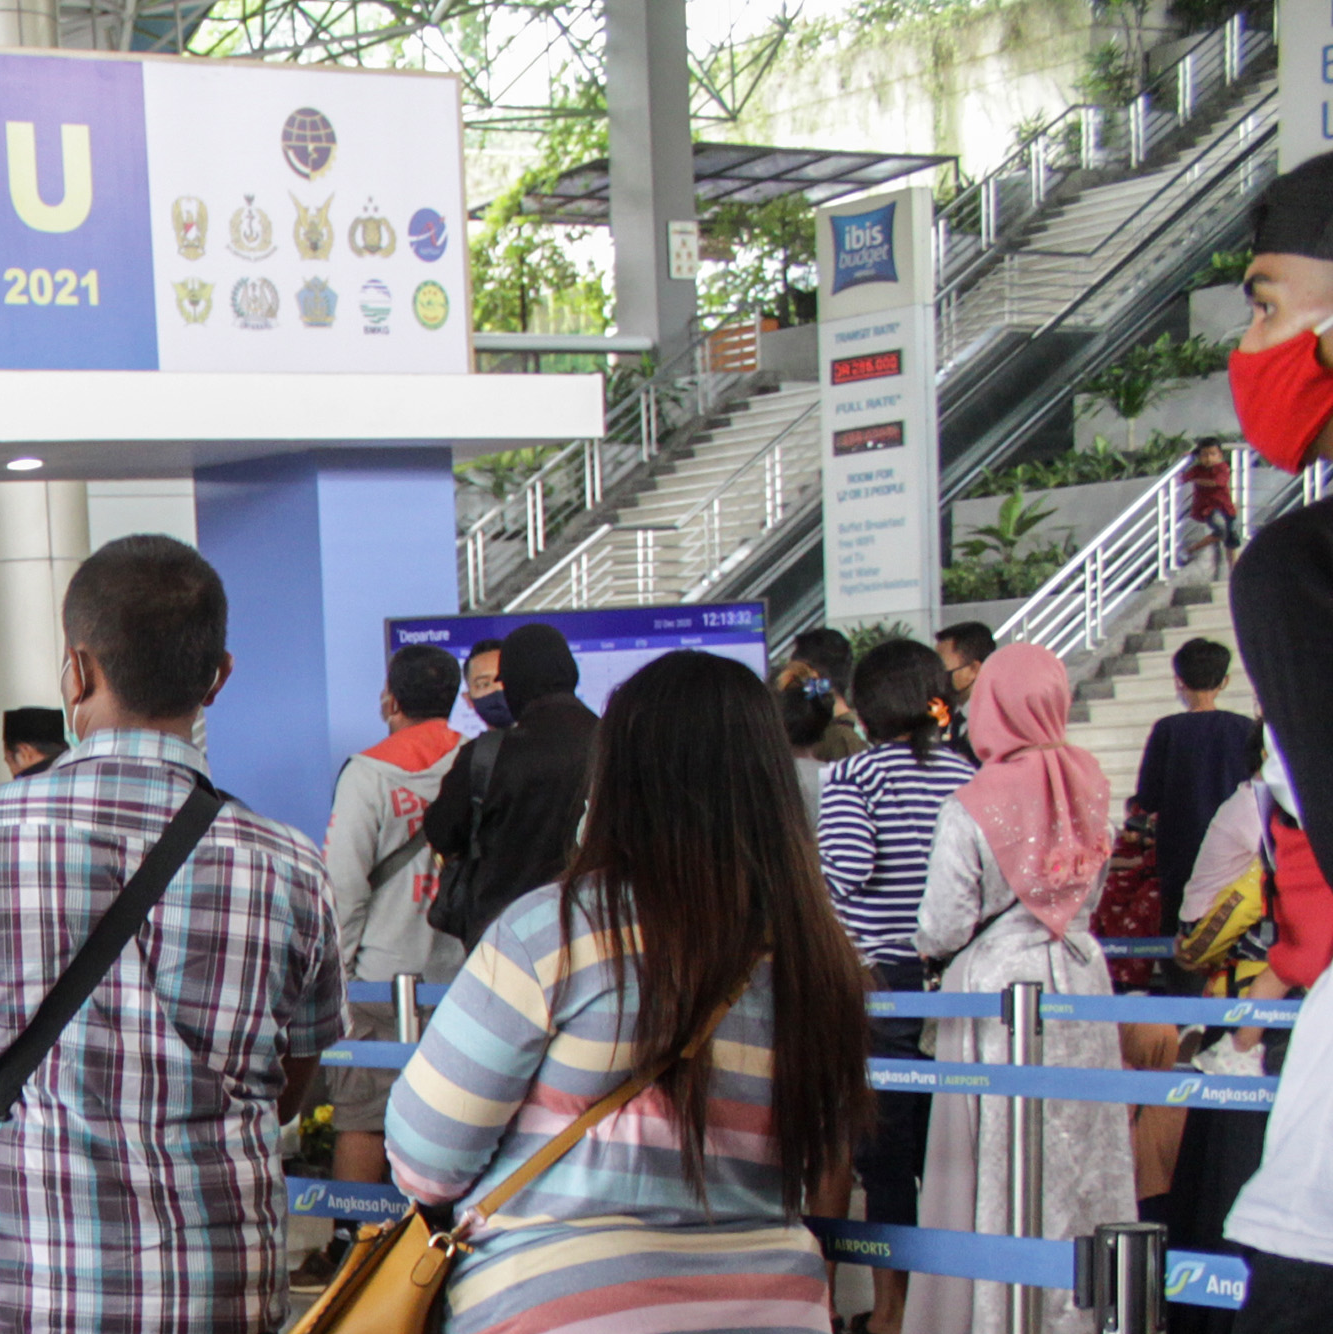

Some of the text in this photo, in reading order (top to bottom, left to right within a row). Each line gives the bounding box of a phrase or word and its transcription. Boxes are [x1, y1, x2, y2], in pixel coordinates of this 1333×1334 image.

[845, 222, 883, 251] ibis
[839, 245, 889, 269] budget
[3, 268, 99, 306] 2021
[702, 610, 751, 627] 12:13:32
[399, 627, 450, 643] Departure
[944, 1075, 990, 1087] AIRPORTS
[834, 1240, 891, 1257] AIRPORTS
